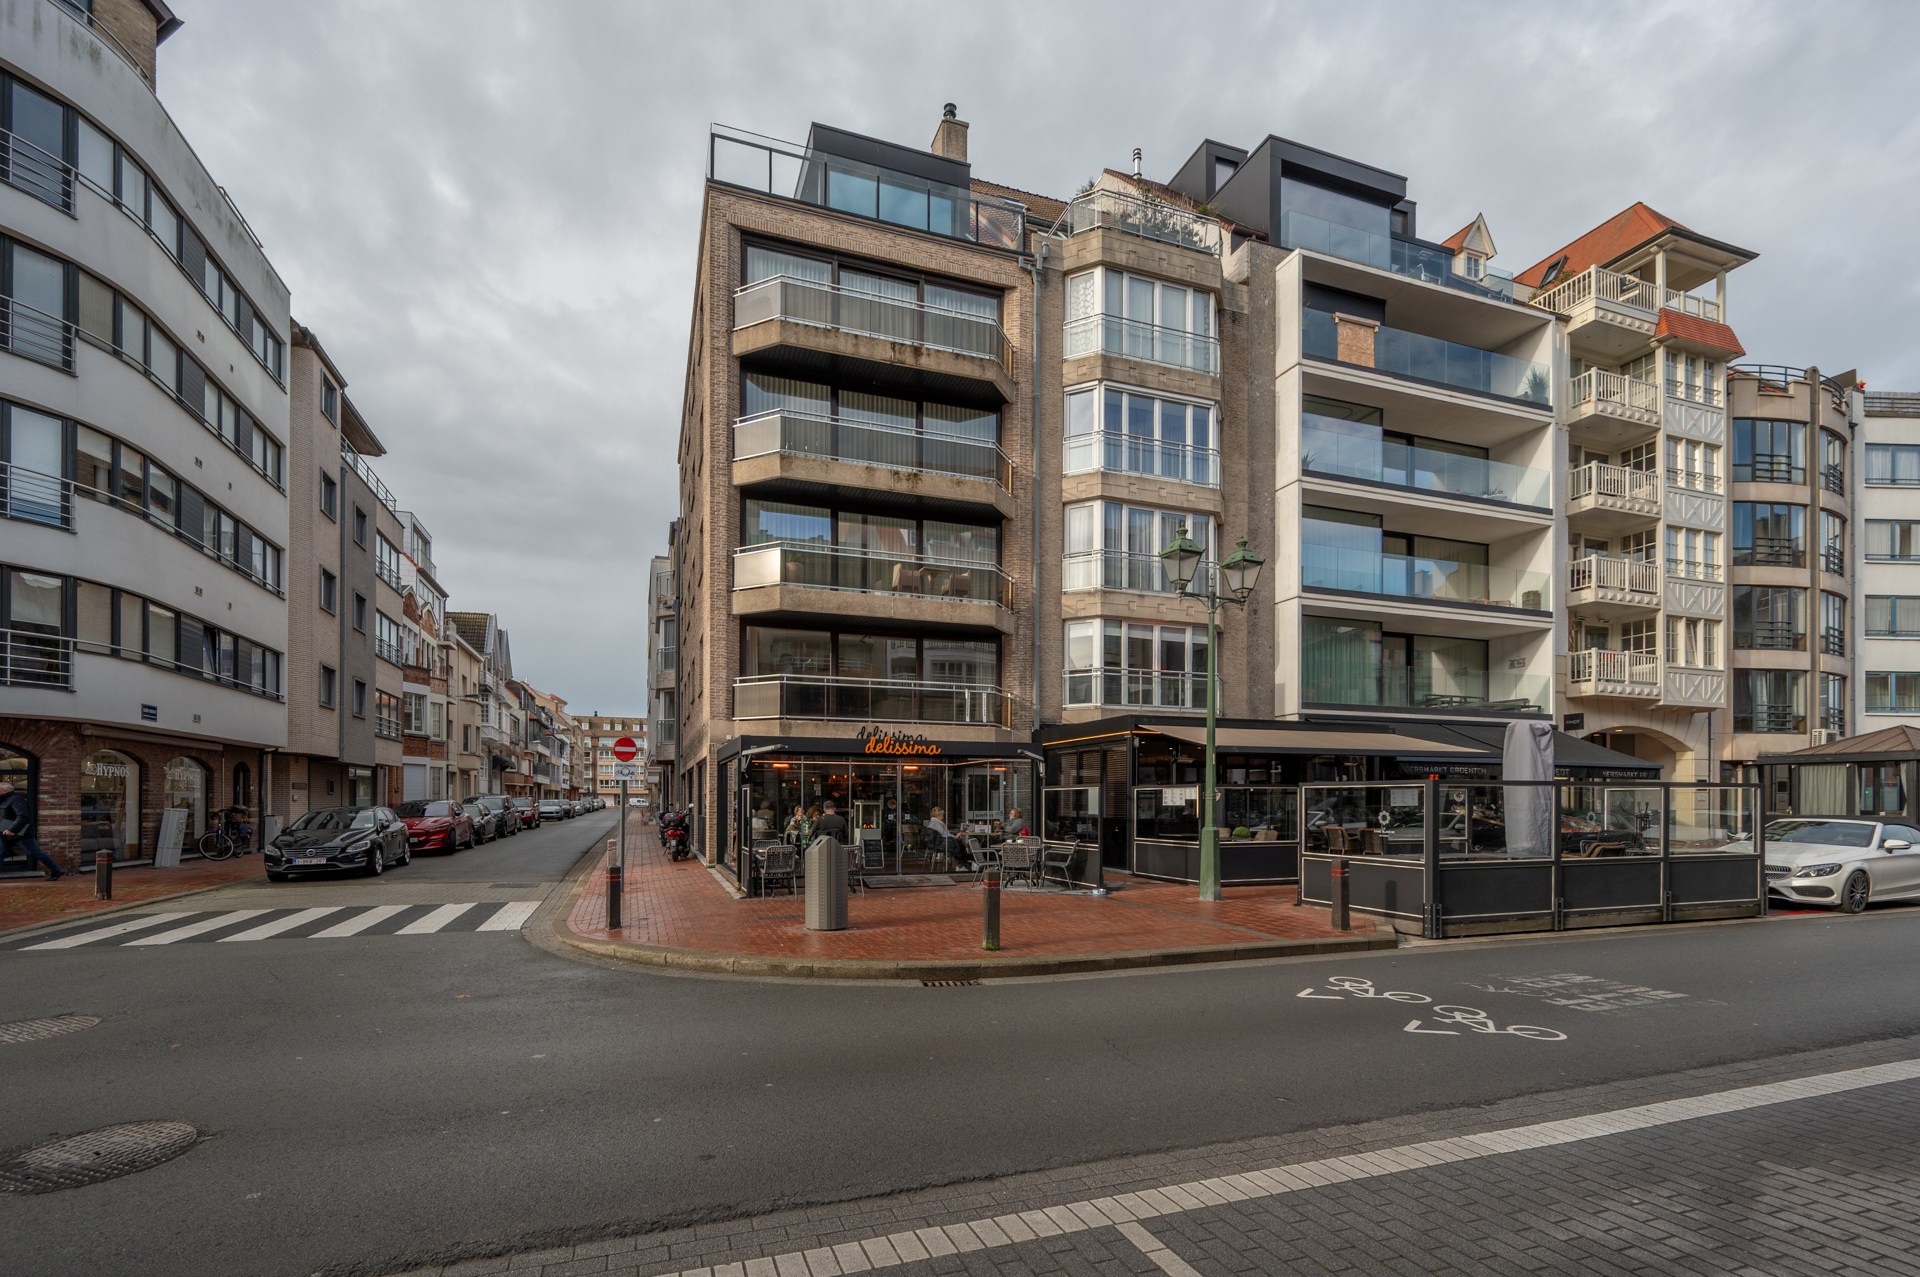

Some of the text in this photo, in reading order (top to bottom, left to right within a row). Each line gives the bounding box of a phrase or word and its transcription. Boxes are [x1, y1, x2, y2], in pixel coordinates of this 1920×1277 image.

[865, 736, 942, 755] delissima
[96, 763, 130, 777] HYPNOS
[1408, 766, 1448, 774] ERSMARKT
